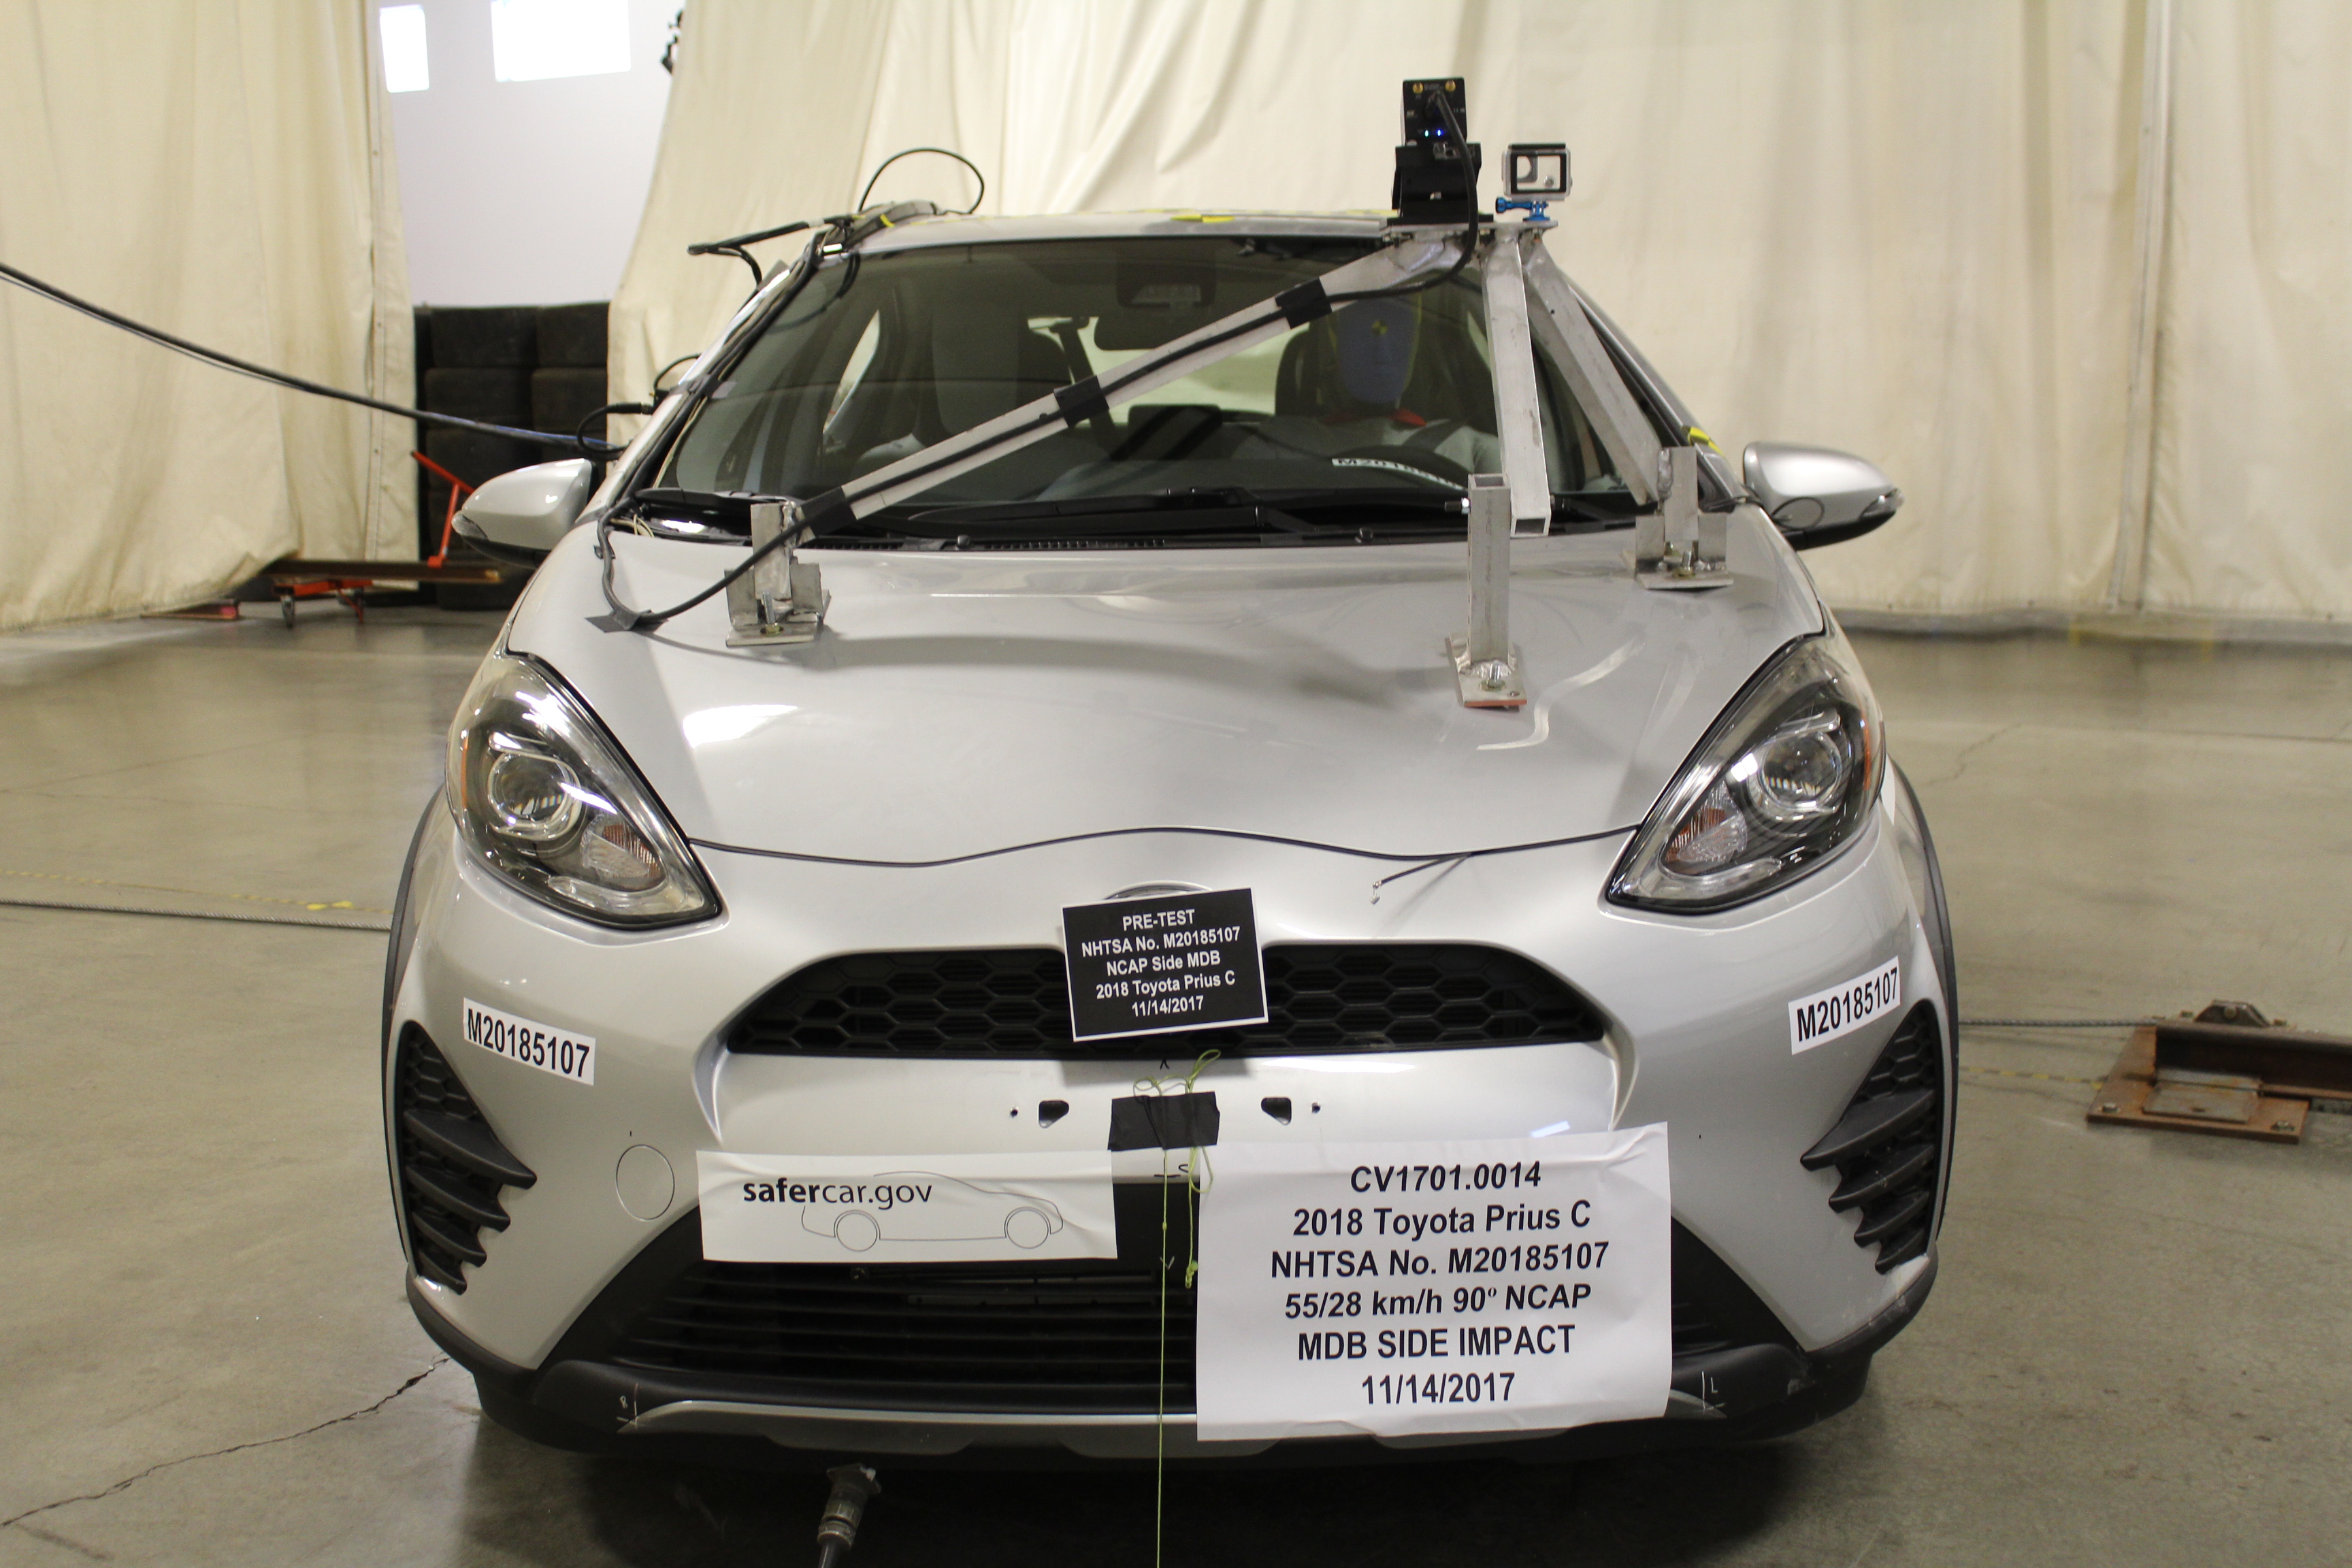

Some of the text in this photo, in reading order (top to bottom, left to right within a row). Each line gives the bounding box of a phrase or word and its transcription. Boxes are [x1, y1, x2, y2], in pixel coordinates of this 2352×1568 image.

[1123, 909, 1194, 931] PRE-TEST
[1082, 926, 1240, 957] NHTSA No. M20185107
[1107, 950, 1220, 976] NCAP Side MDB
[1096, 970, 1235, 998] 2018 Toyota Prius C
[1132, 996, 1204, 1017] 11/14/2017
[1797, 966, 1897, 1043] M20185107
[468, 1009, 589, 1077] M20185107
[1351, 1162, 1541, 1192] CV1701.0014
[743, 1178, 932, 1209] safercar.gov
[1294, 1200, 1590, 1241] 2018 Toyota Prius C
[1271, 1242, 1609, 1278] NHTSA No. M20185107
[1286, 1292, 1361, 1319] 55/28
[1372, 1290, 1442, 1316] km/h
[1505, 1284, 1591, 1311] NCAP
[1298, 1324, 1575, 1361] MDB SIDE IMPACT
[1362, 1373, 1515, 1405] 11/14/2017
